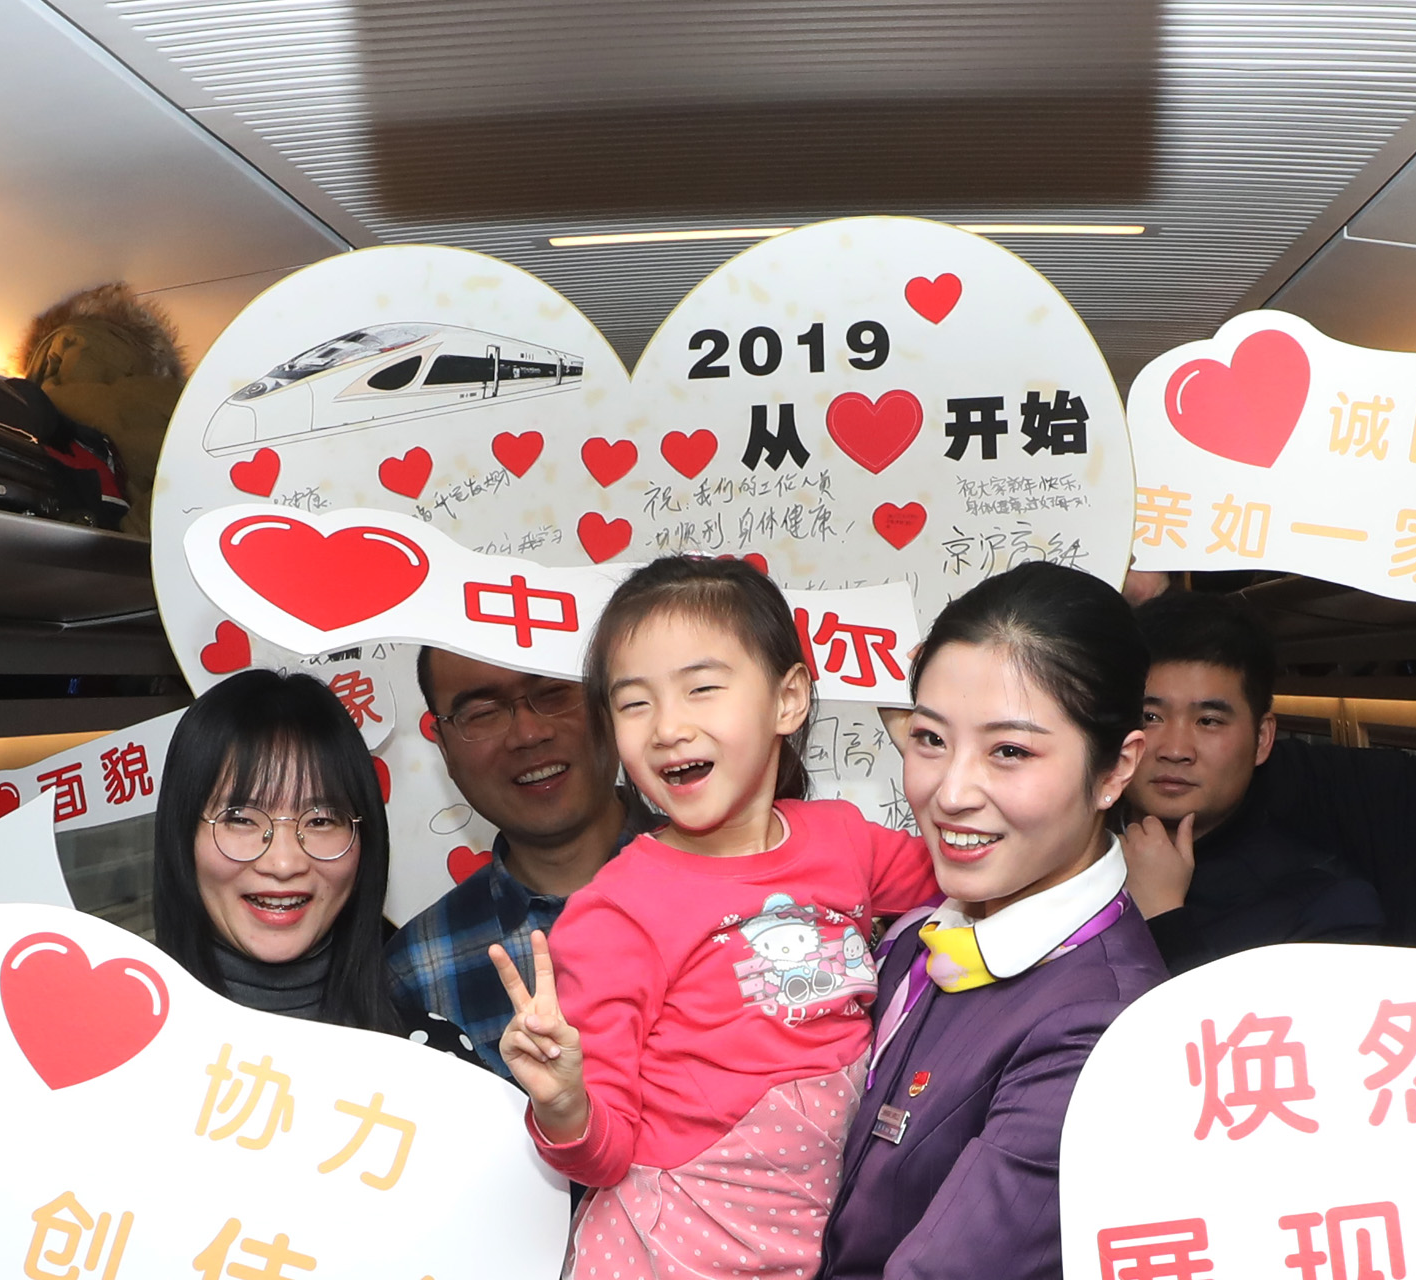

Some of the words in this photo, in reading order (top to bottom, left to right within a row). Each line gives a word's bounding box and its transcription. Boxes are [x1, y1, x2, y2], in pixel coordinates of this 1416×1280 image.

[688, 320, 890, 380] 2019
[741, 403, 811, 472] 从
[944, 389, 1090, 462] 开始
[463, 574, 580, 649] 中
[793, 607, 906, 688] 你
[36, 742, 154, 823] 面貌
[195, 1043, 417, 1191] 协力
